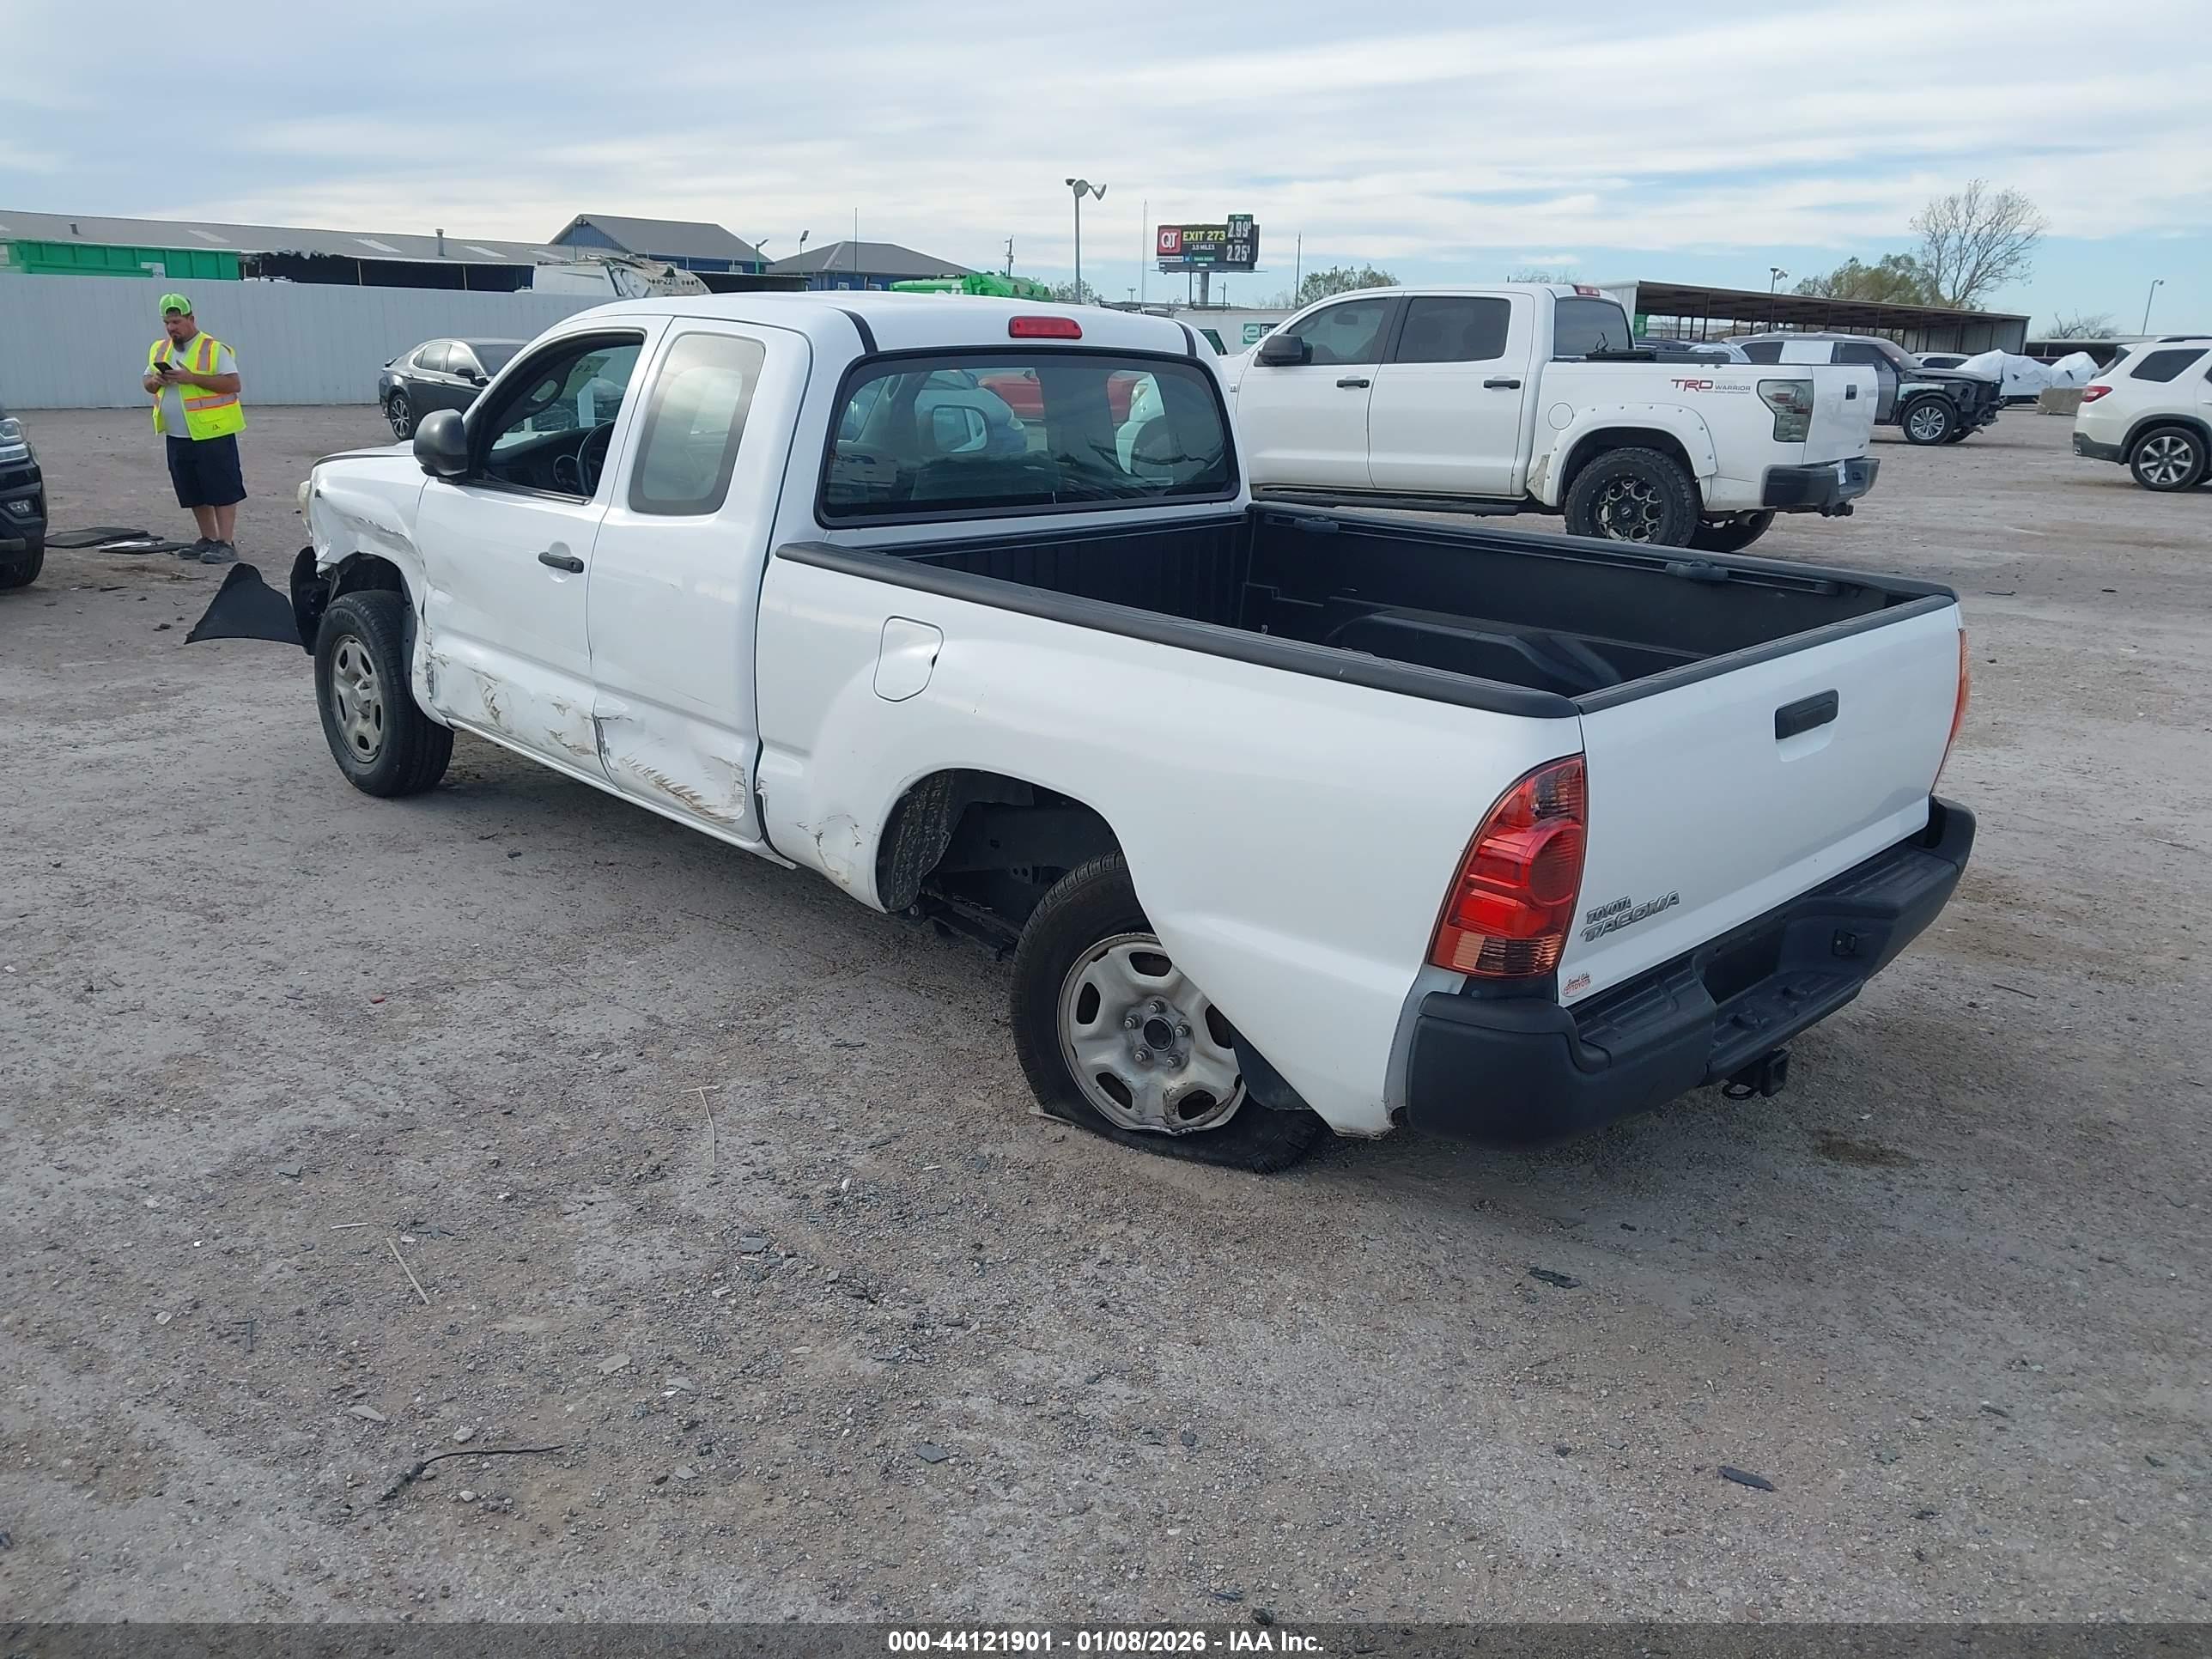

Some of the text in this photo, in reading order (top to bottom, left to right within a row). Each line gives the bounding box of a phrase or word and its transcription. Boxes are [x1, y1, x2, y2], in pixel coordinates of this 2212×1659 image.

[1161, 232, 1177, 249] QT
[1182, 231, 1205, 241] EXIT
[1206, 230, 1226, 241] 273
[1671, 379, 1714, 392] TRD
[1579, 890, 1680, 942] TACOMA
[1586, 895, 1632, 925] TOYOTA
